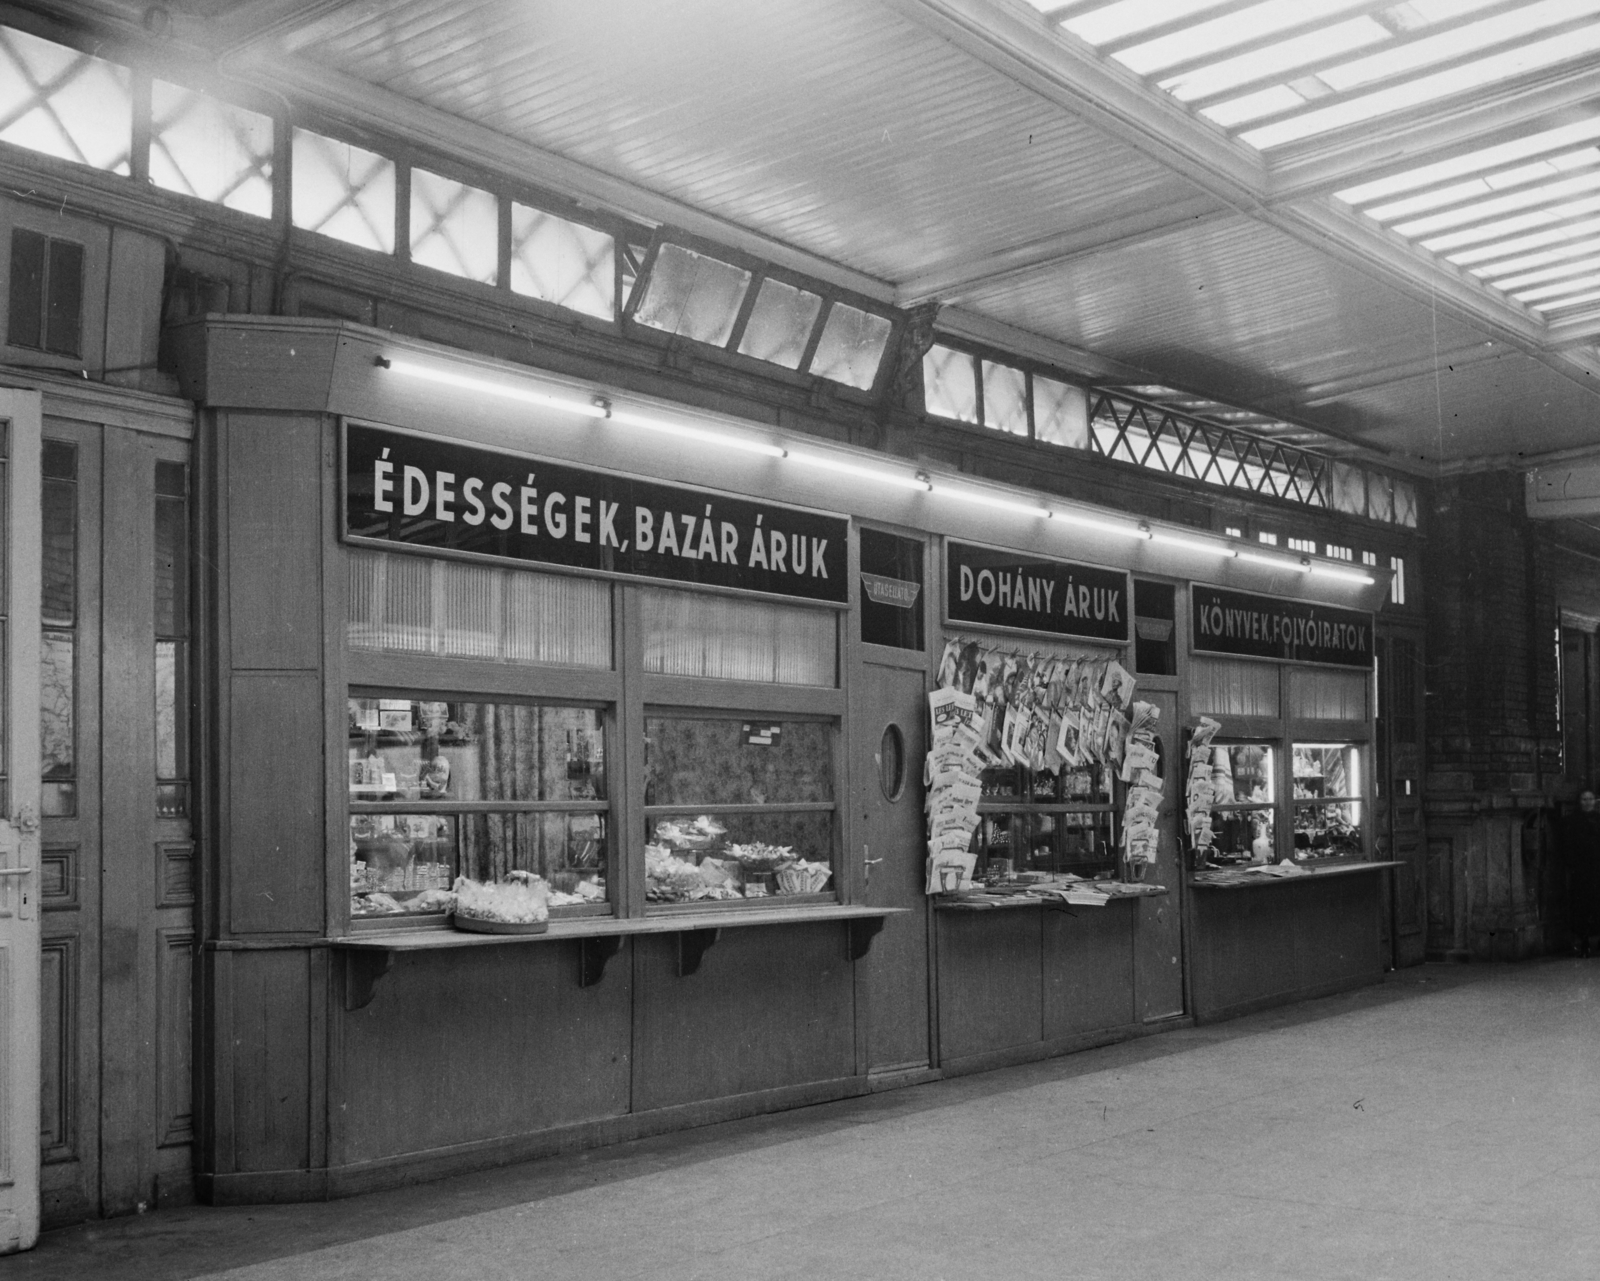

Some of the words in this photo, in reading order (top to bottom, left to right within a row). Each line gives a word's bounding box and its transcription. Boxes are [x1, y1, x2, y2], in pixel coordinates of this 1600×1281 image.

[374, 448, 629, 553] ÉDESSÉGEK,
[635, 504, 738, 565] BAZÁR
[748, 514, 828, 579] ÁRUK
[960, 564, 1055, 614] DOHÁNY
[1064, 576, 1121, 623] ÁRUK
[1200, 597, 1273, 643] KÖNYVEK,
[1273, 610, 1366, 652] FOLYÓIRATOK
